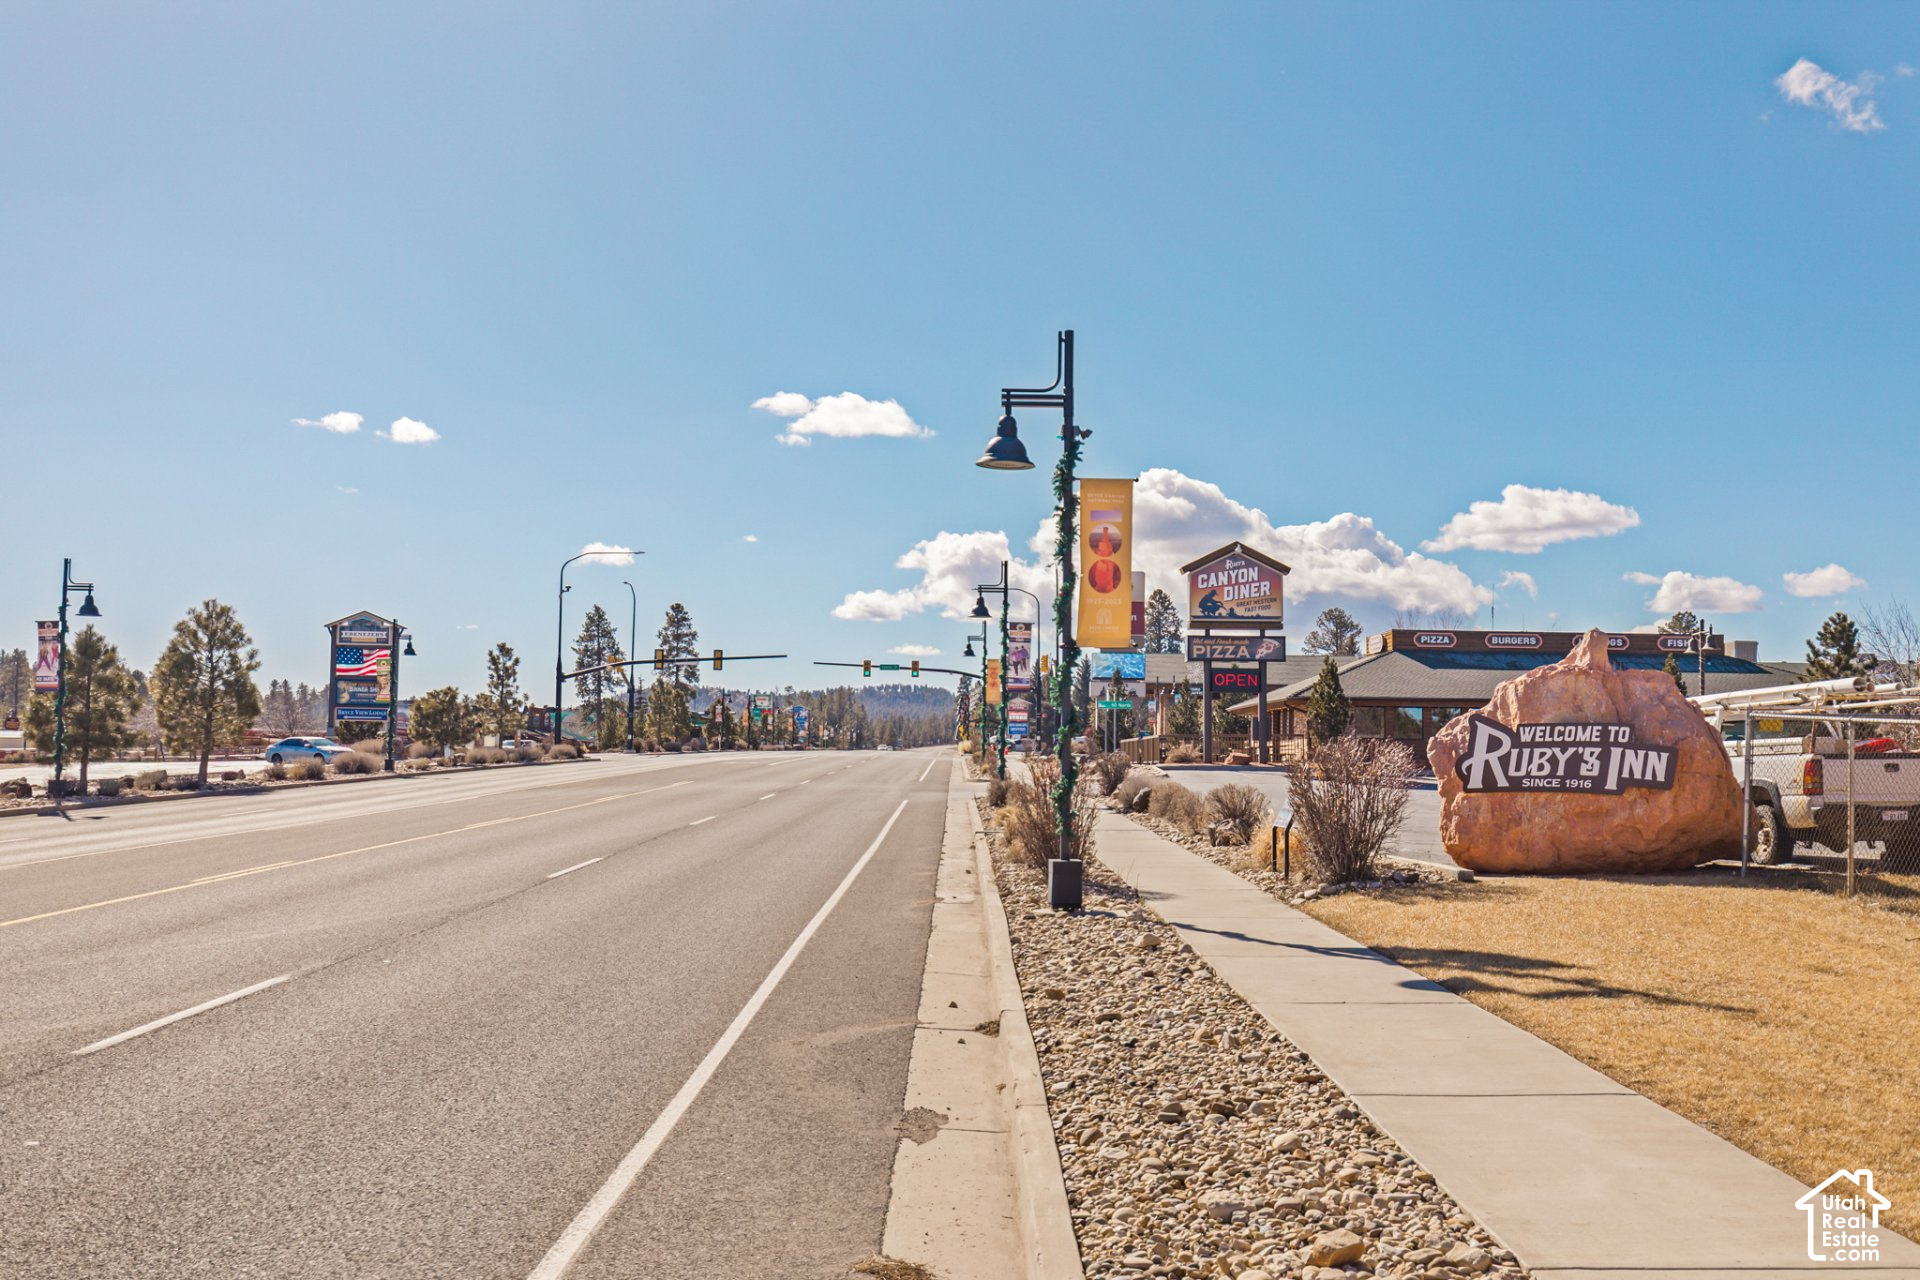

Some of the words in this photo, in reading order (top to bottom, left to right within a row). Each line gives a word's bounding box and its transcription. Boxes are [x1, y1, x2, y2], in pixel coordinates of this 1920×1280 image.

[1197, 567, 1259, 589] CANYON
[1223, 580, 1271, 602] DINER
[1236, 600, 1252, 608] GREAT
[1253, 597, 1277, 606] WESTERN
[1258, 604, 1272, 612] FOOD
[1420, 635, 1450, 644] PIZZA
[1491, 636, 1537, 645] BURGERS
[1192, 645, 1251, 659] PIZZA
[1214, 673, 1258, 687] OPEN
[1519, 725, 1602, 743] WELCOME
[1607, 726, 1630, 743] TO
[1461, 720, 1602, 789] RUBY'S
[1604, 747, 1670, 790] INN
[1521, 778, 1561, 788] SINCE
[1565, 778, 1592, 789] 1916
